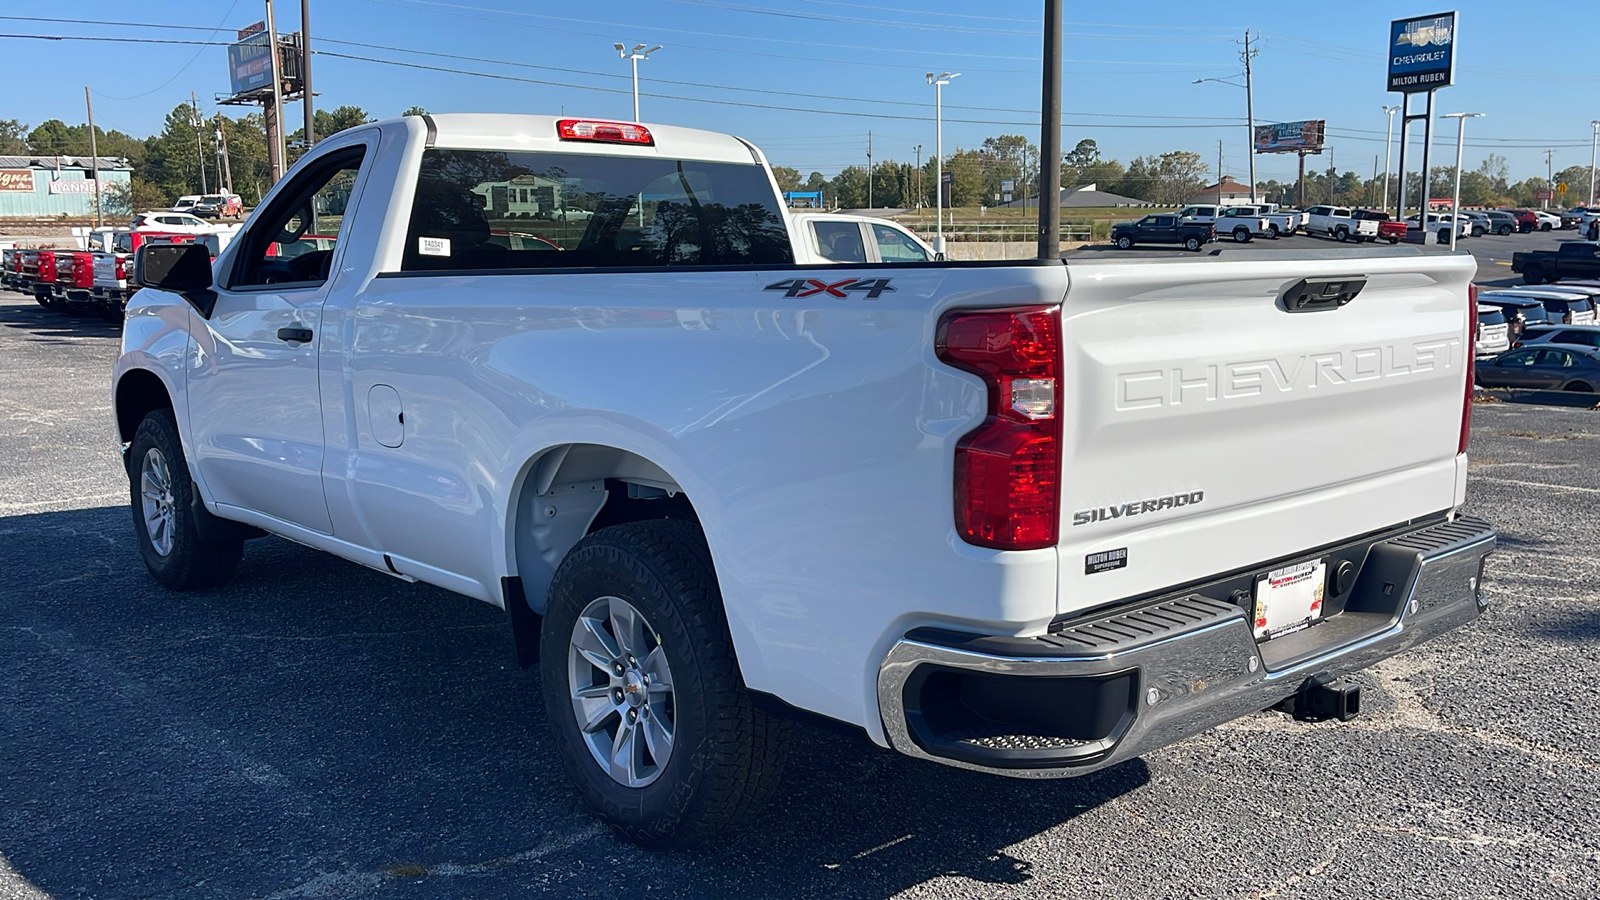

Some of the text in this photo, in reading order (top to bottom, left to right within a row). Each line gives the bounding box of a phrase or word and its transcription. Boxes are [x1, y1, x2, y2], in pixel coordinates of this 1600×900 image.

[1393, 50, 1445, 66] CHEVROLET
[1392, 72, 1445, 86] MILTON RUBEN
[1114, 336, 1461, 412] CHEVROLET
[1072, 489, 1205, 527] SILVERADO
[1088, 549, 1127, 565] MILTON RUBEN
[1094, 560, 1121, 570] SUPERSTORE
[1272, 571, 1313, 586] MILTON RUBEN
[1280, 576, 1313, 588] SUPERSTORE
